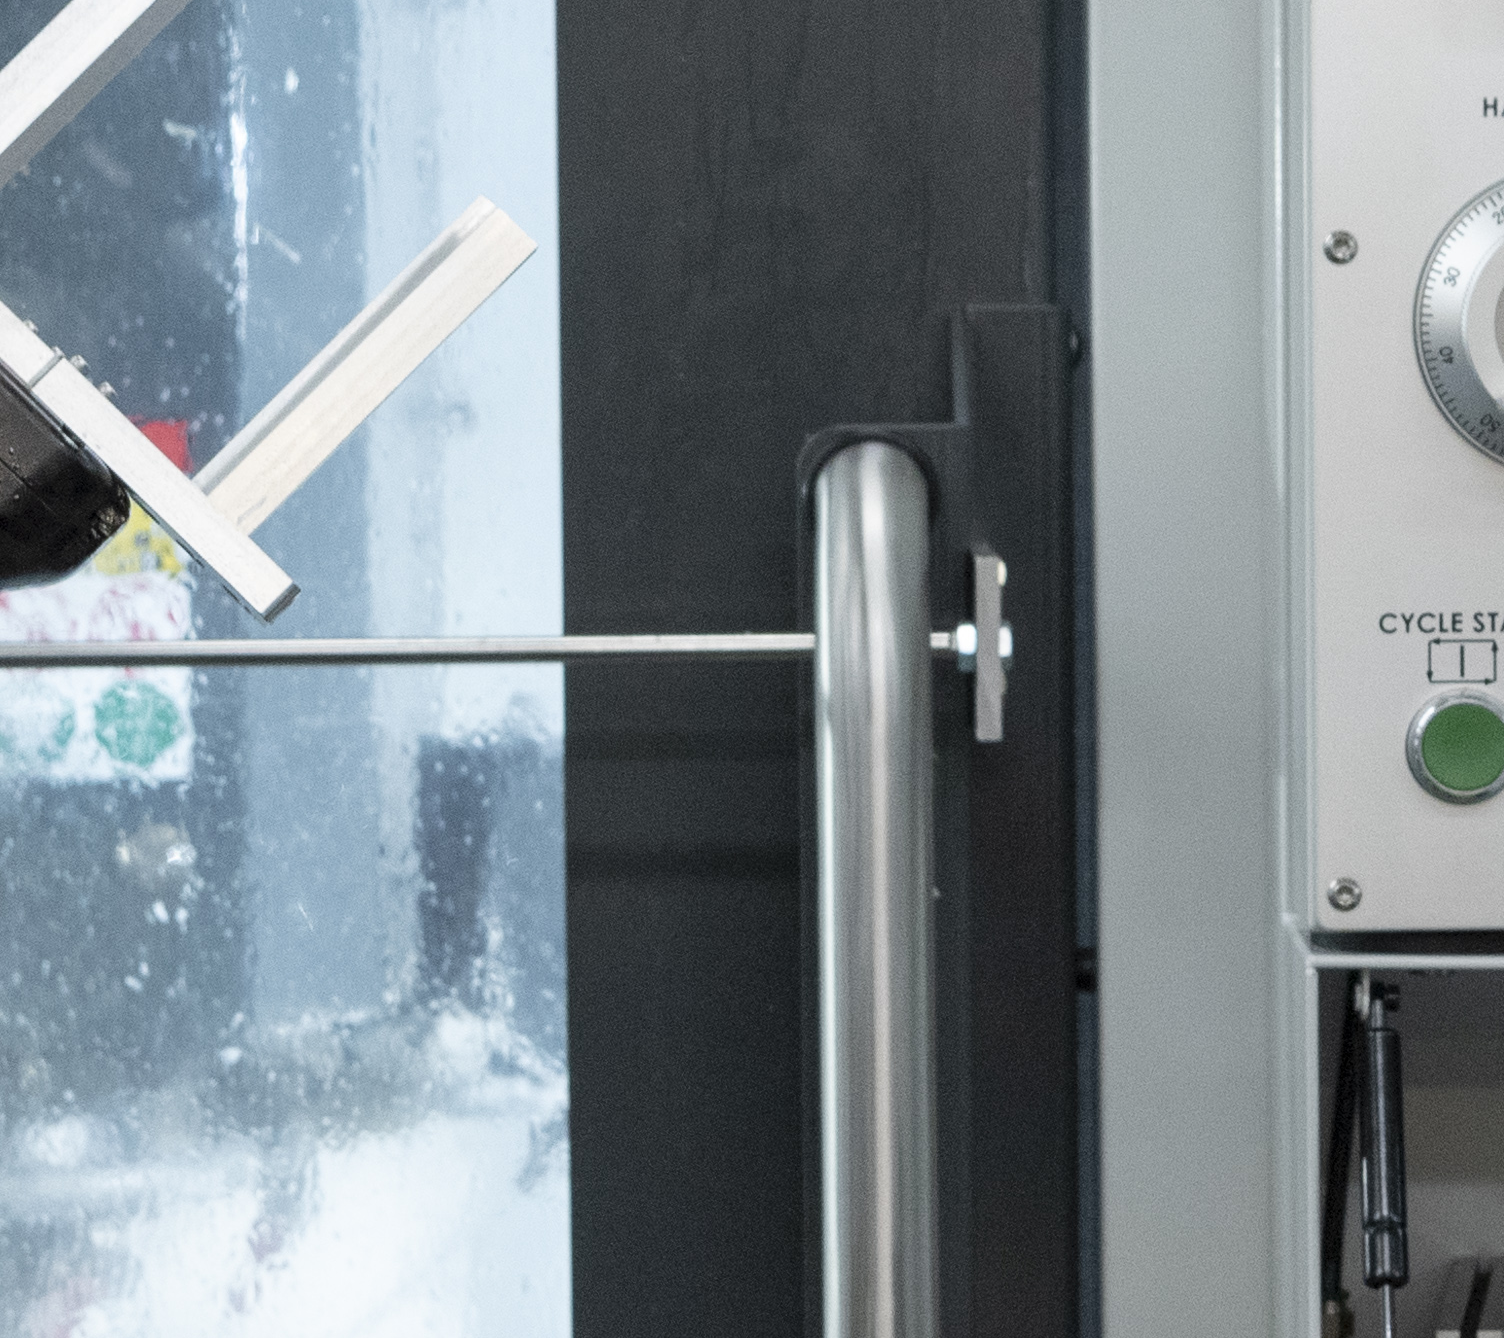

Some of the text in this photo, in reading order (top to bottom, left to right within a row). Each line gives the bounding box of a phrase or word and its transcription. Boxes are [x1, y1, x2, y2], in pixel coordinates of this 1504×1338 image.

[1443, 266, 1461, 288] 30
[1479, 413, 1501, 433] 50
[1379, 612, 1463, 633] CYCLE
